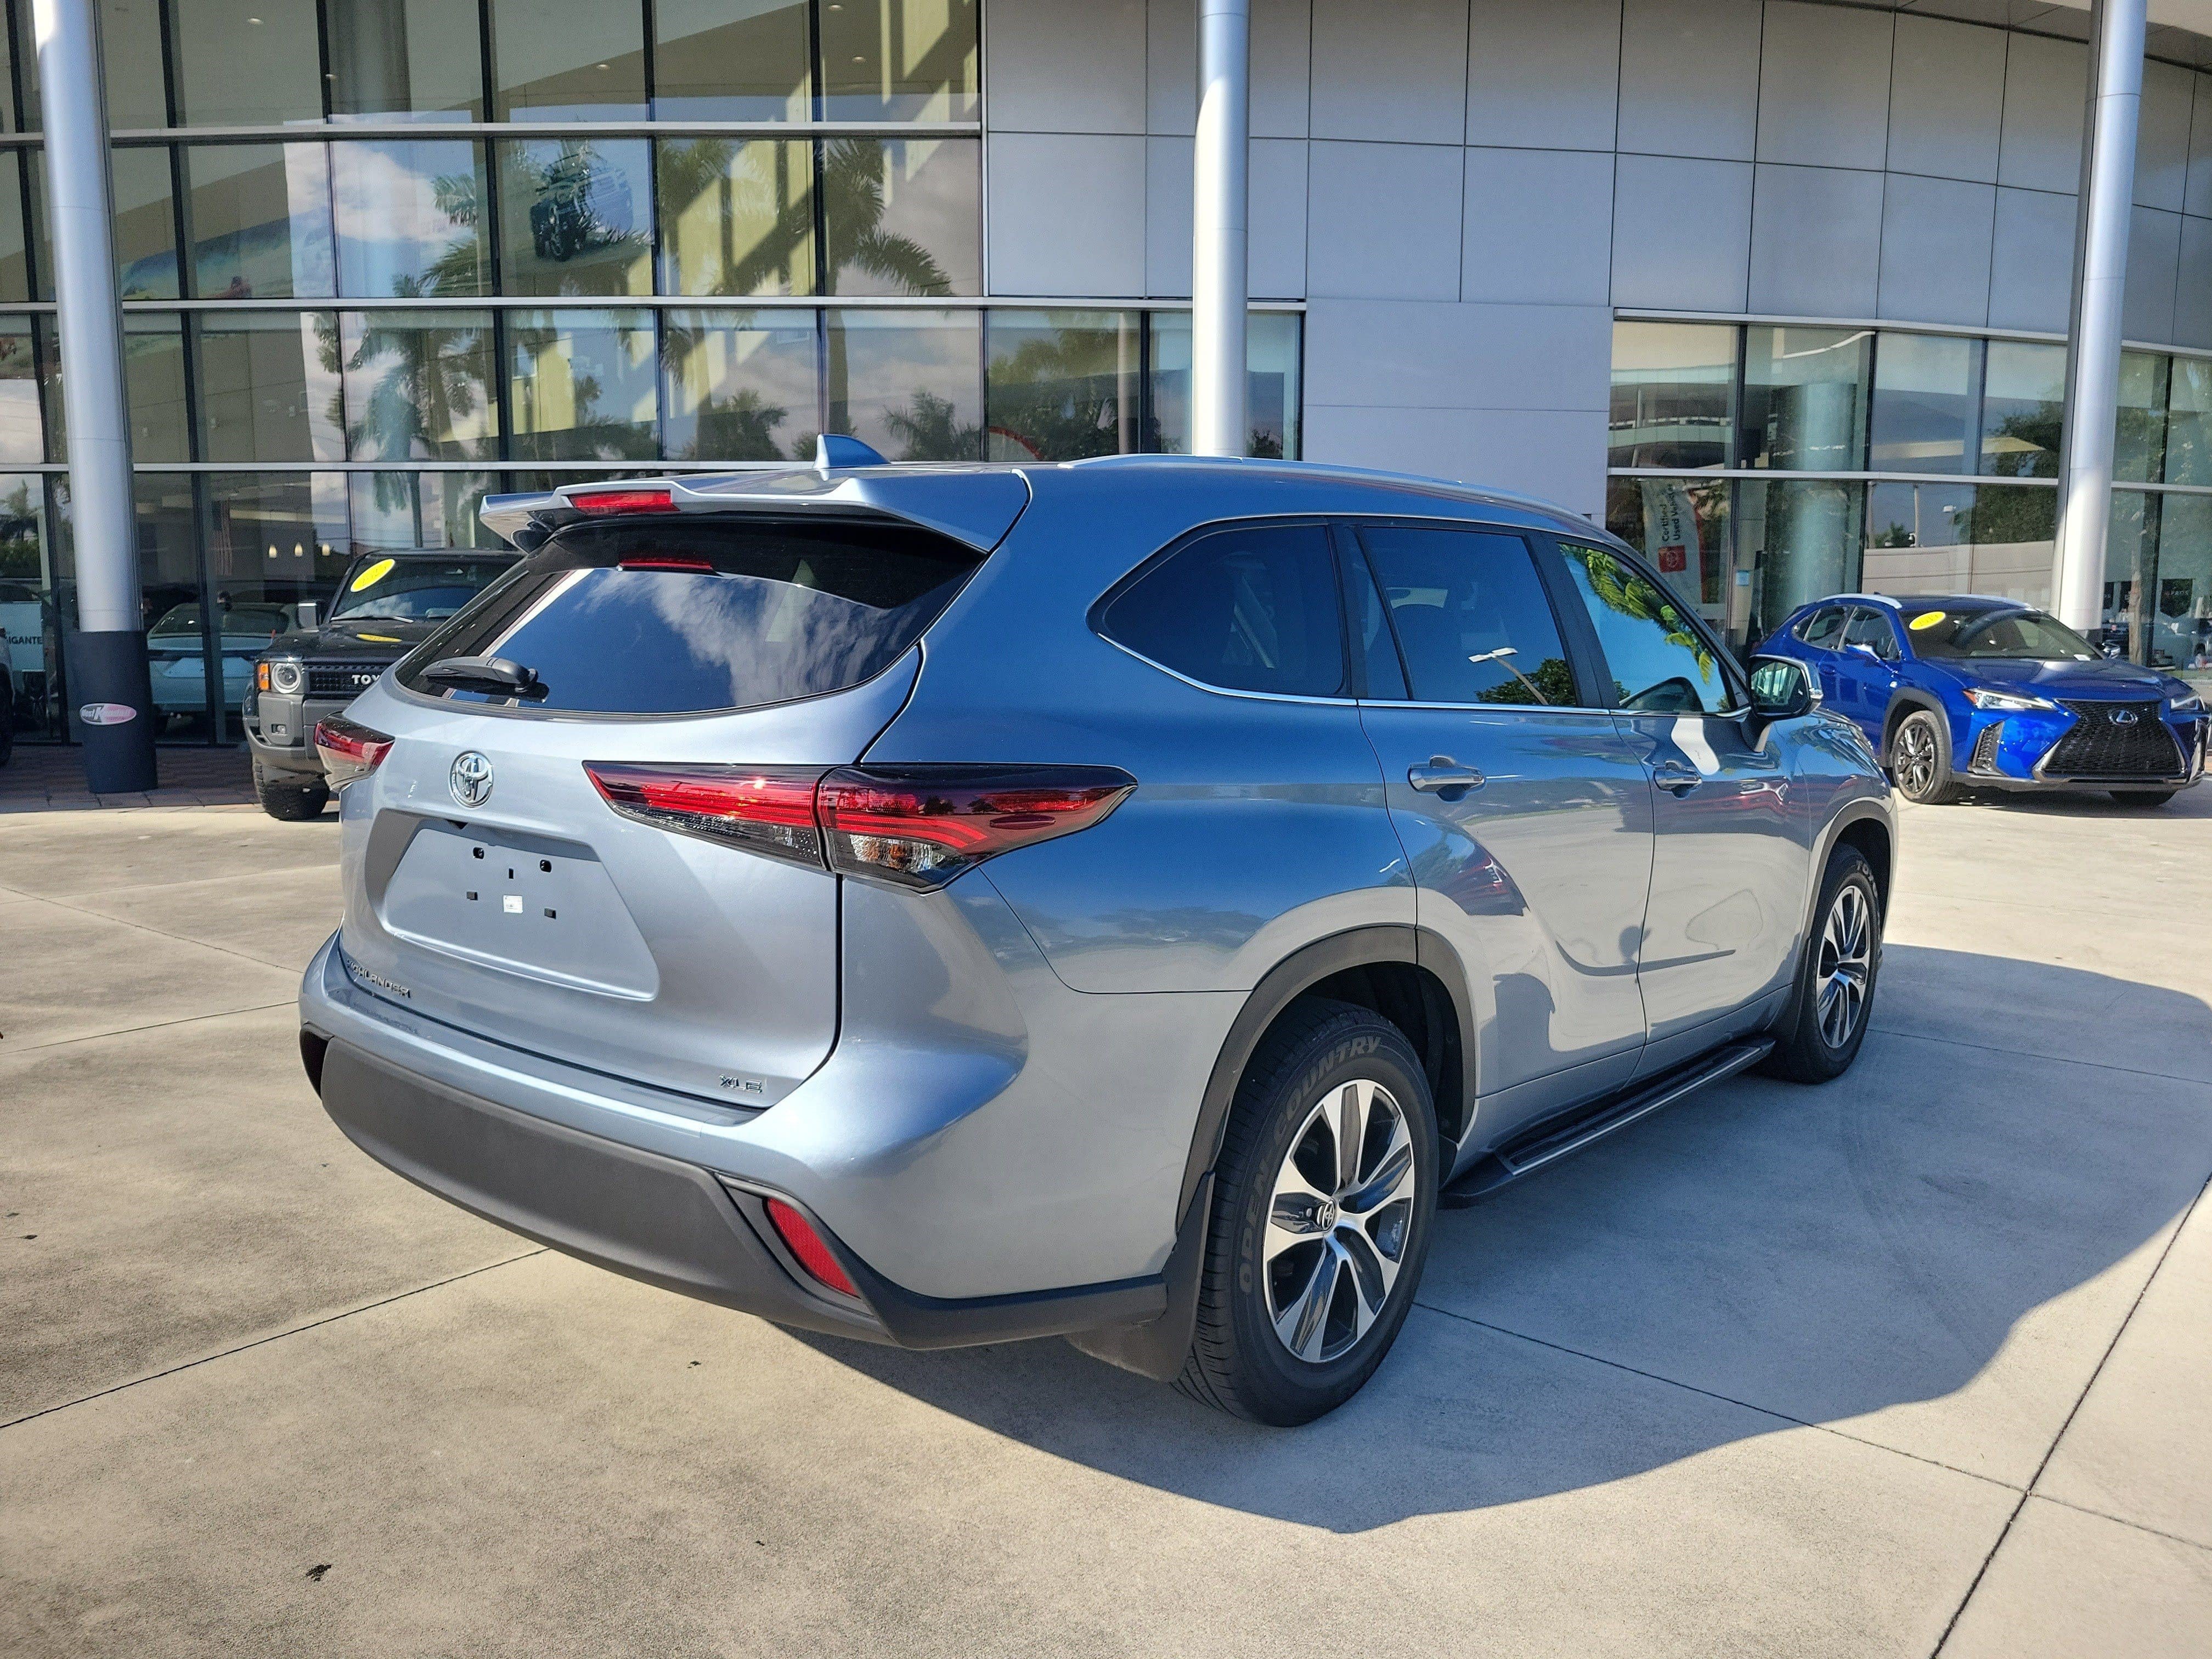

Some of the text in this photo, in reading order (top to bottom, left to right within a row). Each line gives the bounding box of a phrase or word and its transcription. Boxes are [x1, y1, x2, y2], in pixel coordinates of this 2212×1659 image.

[1660, 504, 1669, 541] Certified
[1672, 518, 1680, 540] Used
[719, 1074, 763, 1093] XLE
[1275, 1035, 1381, 1141] COUNTRY
